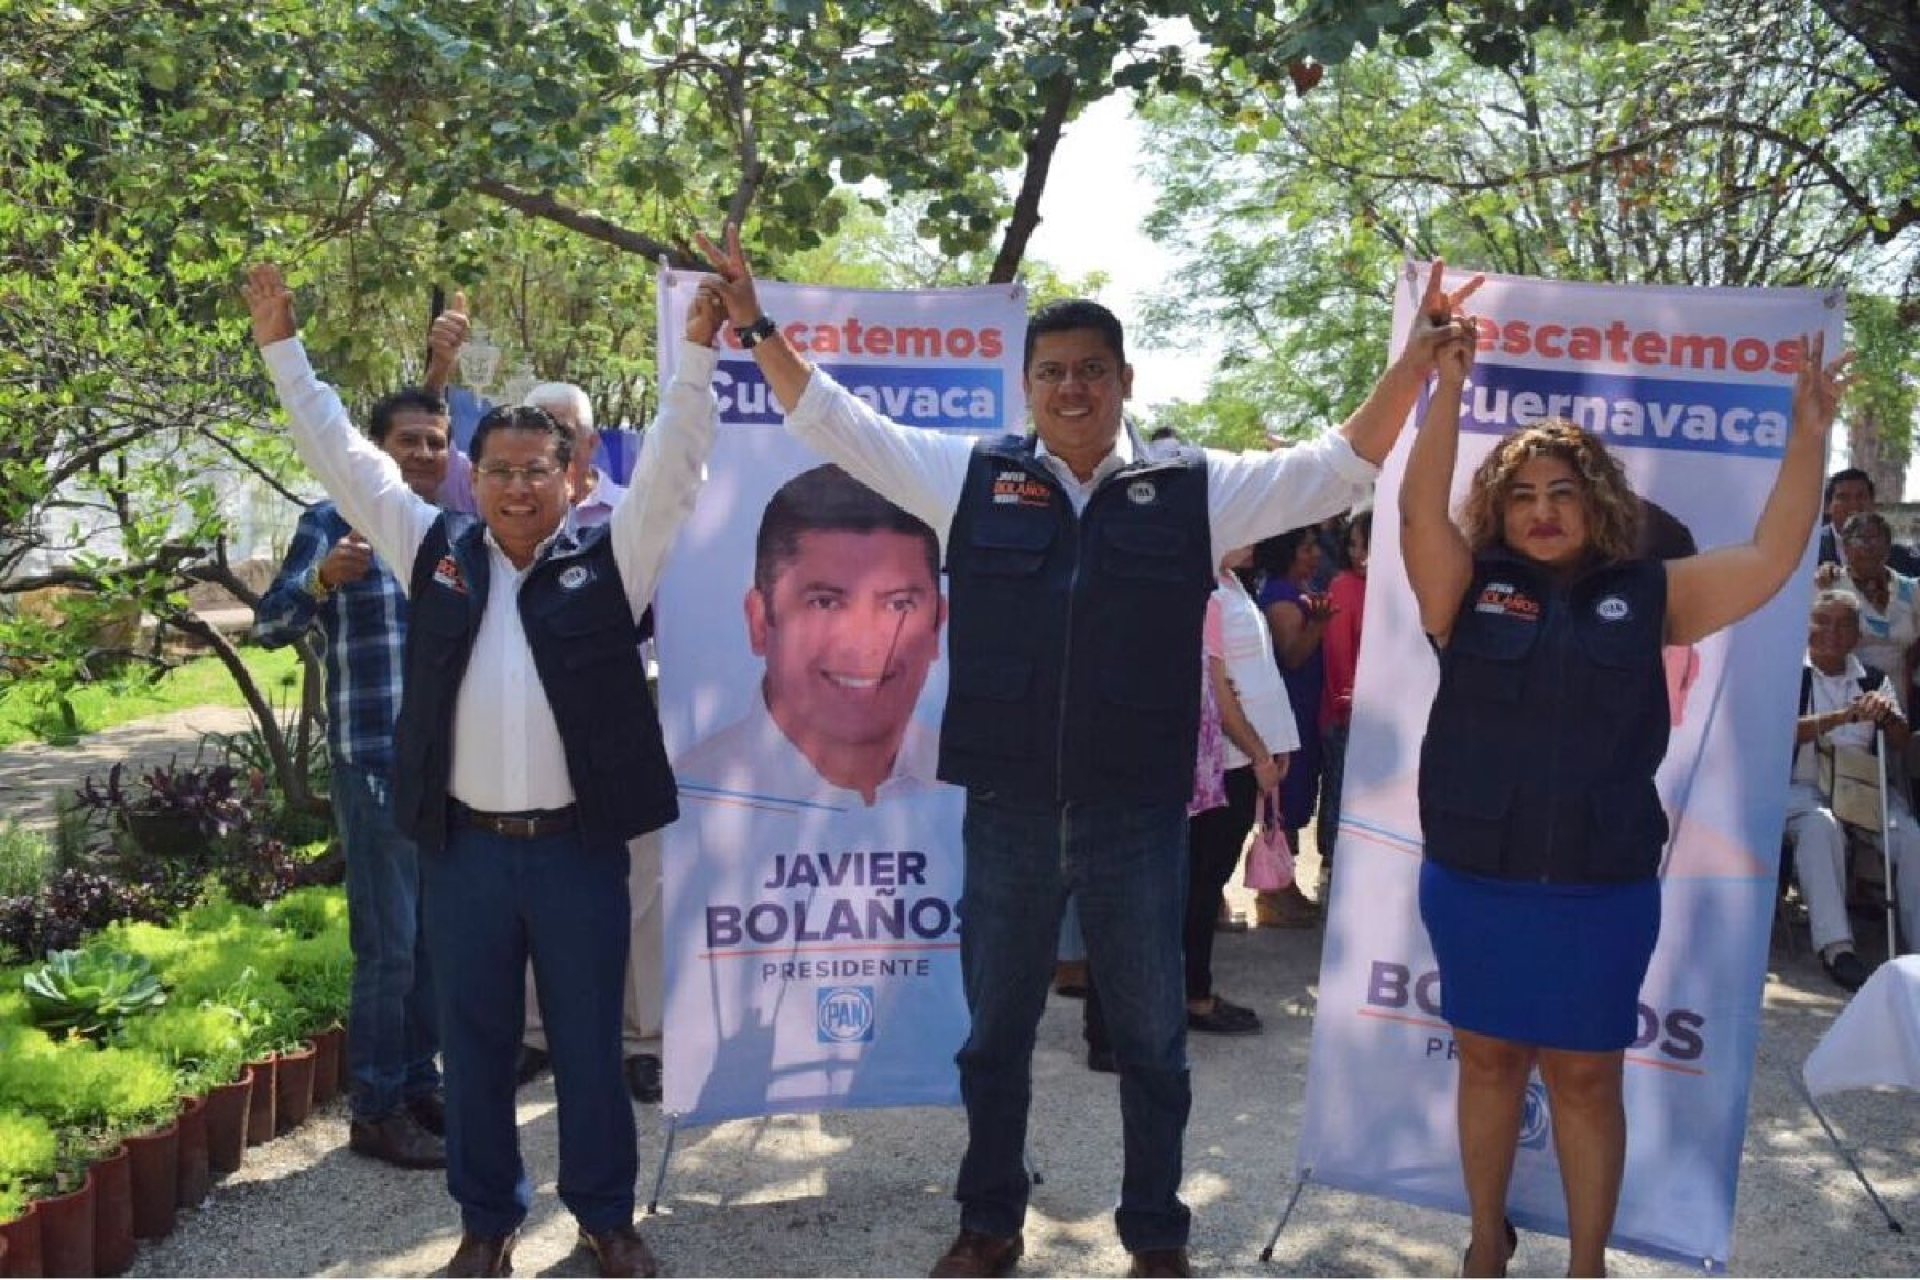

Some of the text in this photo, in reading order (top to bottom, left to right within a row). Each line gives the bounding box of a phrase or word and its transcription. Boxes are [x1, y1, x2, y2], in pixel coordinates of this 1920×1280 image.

[1473, 318, 1801, 374] escatemos
[711, 369, 996, 418] Cuavaca
[764, 851, 927, 889] JAVIER
[762, 959, 930, 982] PRESIDENTE
[828, 1002, 864, 1027] PAN
